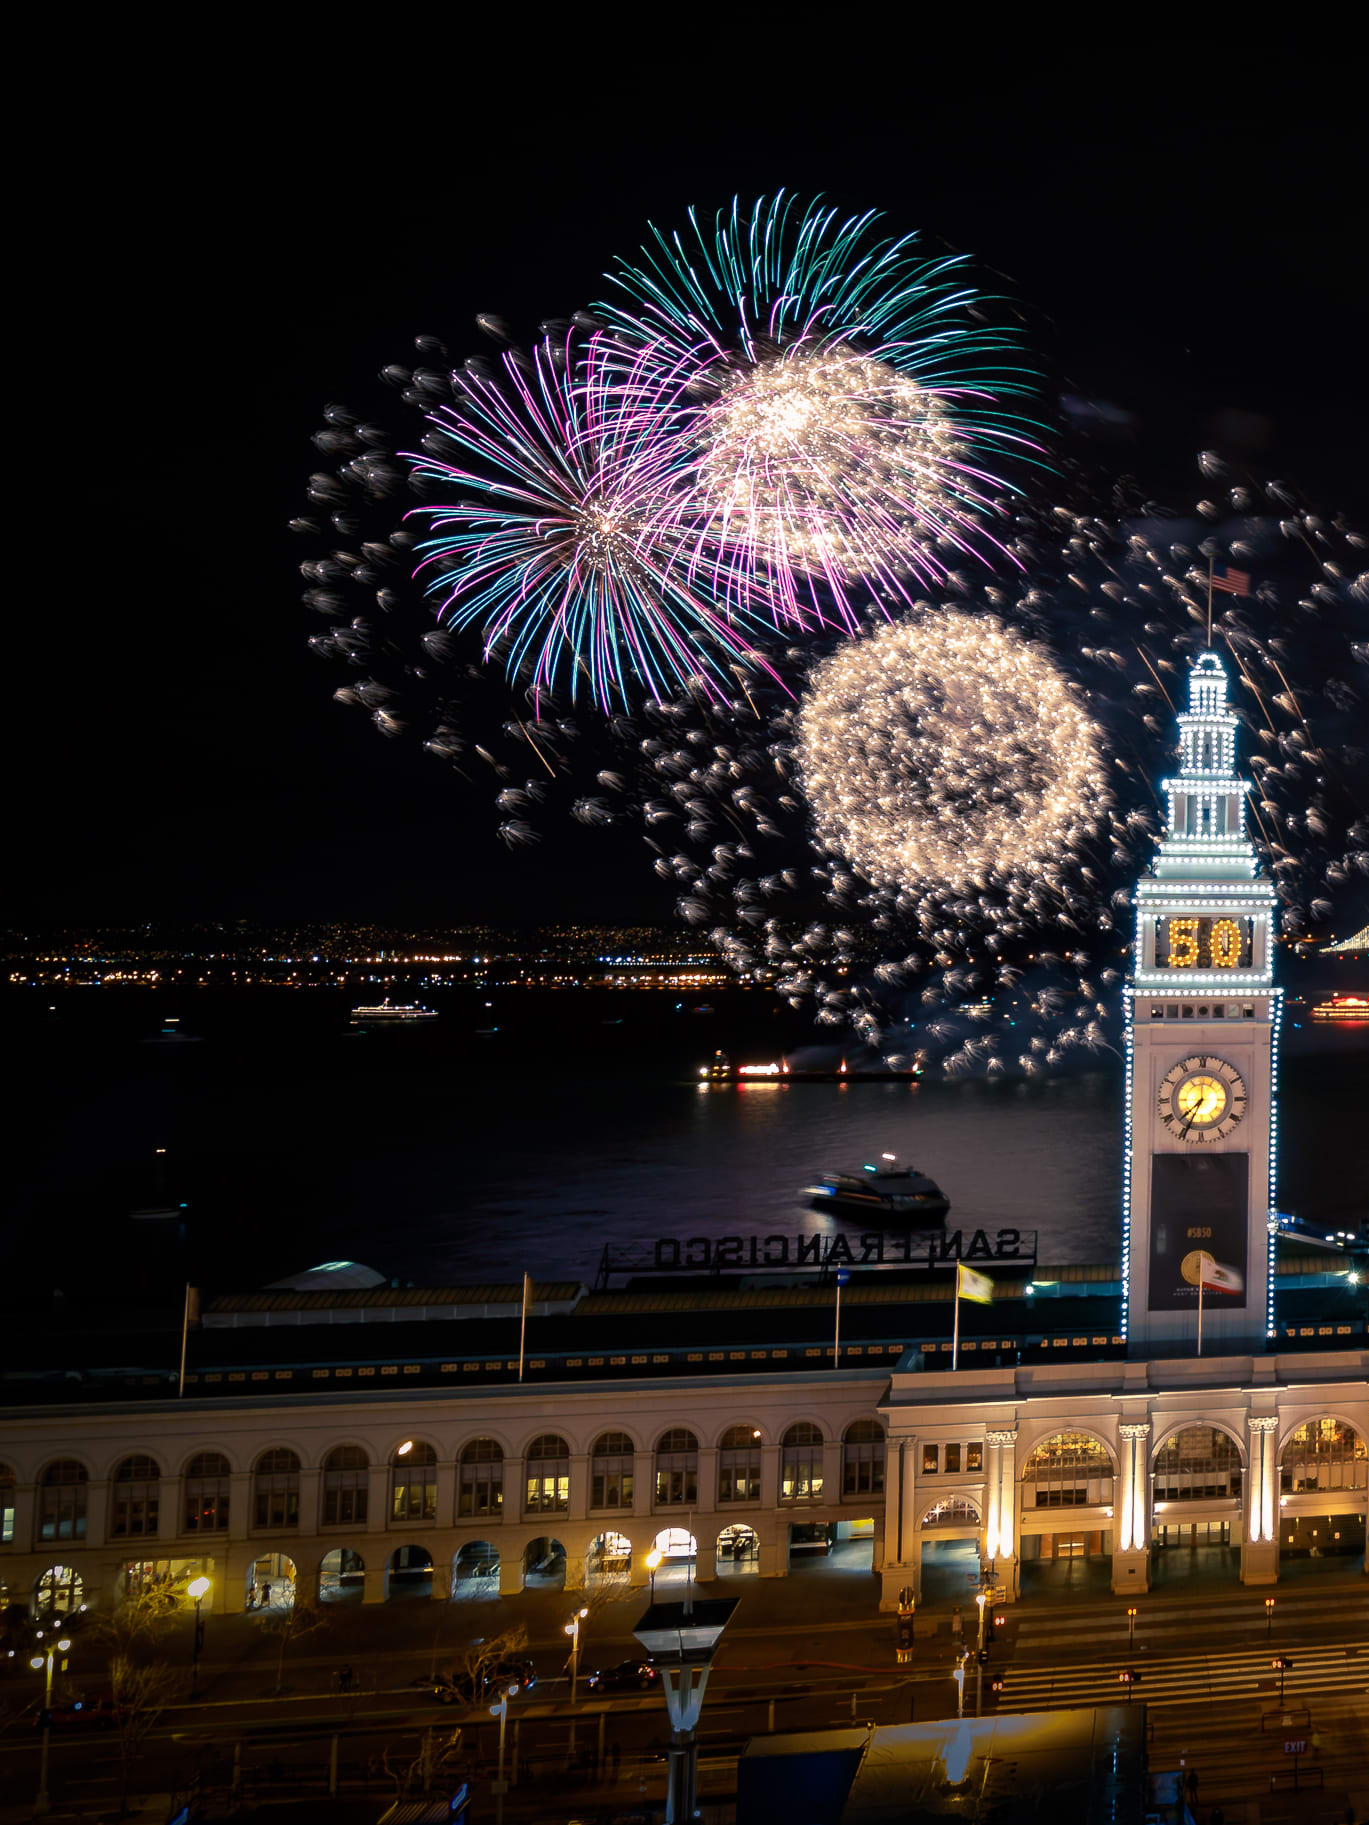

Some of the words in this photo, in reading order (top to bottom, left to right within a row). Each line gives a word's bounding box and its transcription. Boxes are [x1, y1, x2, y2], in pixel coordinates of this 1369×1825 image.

[1168, 919, 1242, 967] 50
[1187, 1226, 1212, 1238] #SB50
[1284, 1740, 1306, 1753] EXIT
